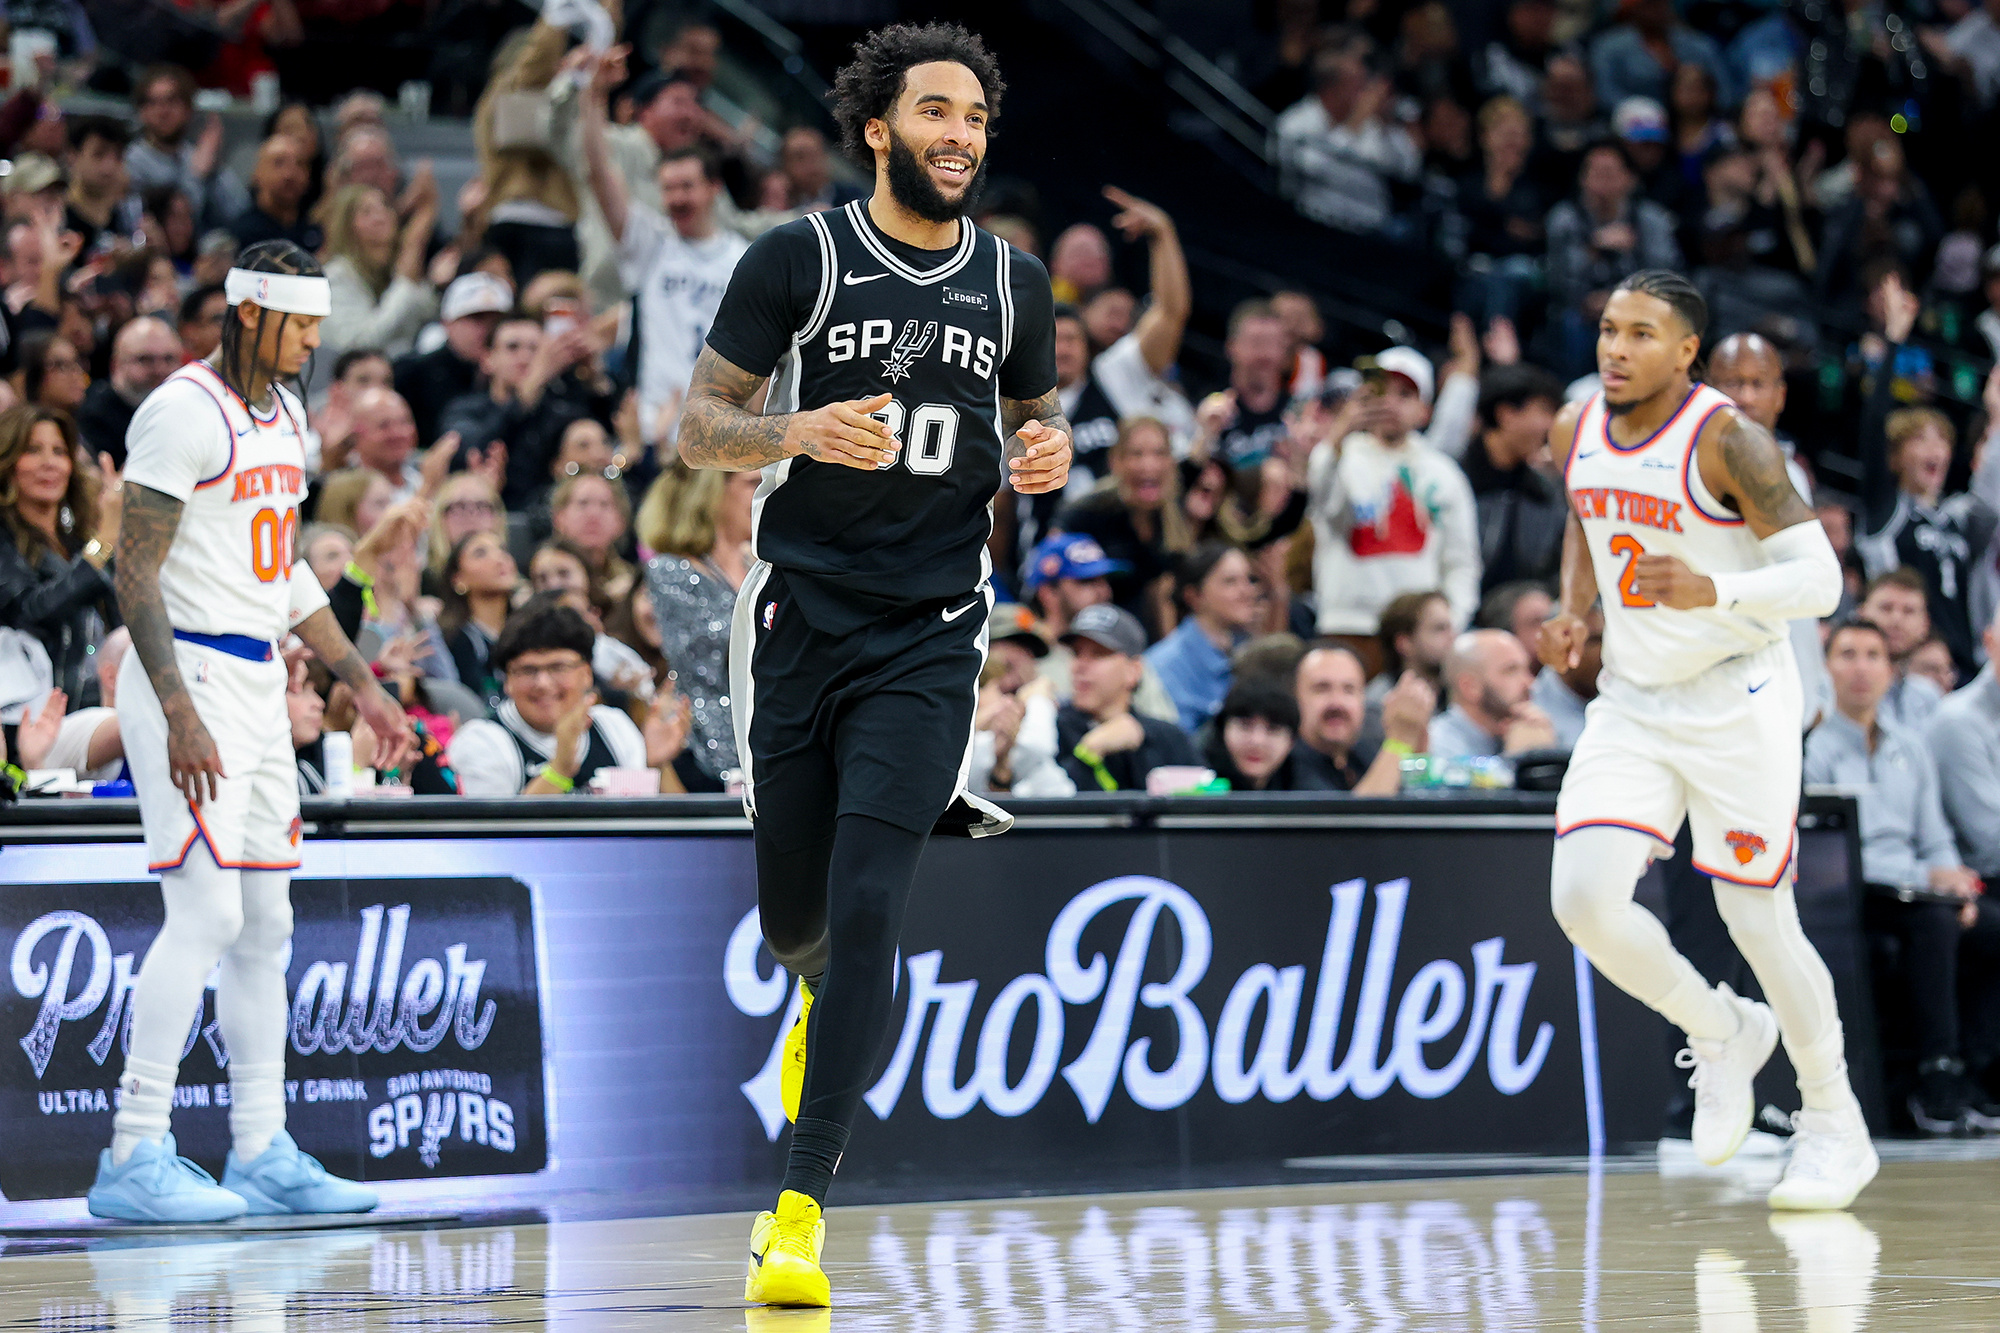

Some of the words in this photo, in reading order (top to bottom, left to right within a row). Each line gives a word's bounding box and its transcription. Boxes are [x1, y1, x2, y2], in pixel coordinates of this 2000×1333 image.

[948, 292, 983, 306] LEDGER
[828, 319, 997, 385] SPURS
[231, 465, 274, 503] NEW
[1572, 488, 1609, 519] EW
[1612, 488, 1684, 534] YORK
[38, 1088, 110, 1115] ULTRA
[367, 1091, 516, 1169] SPURS
